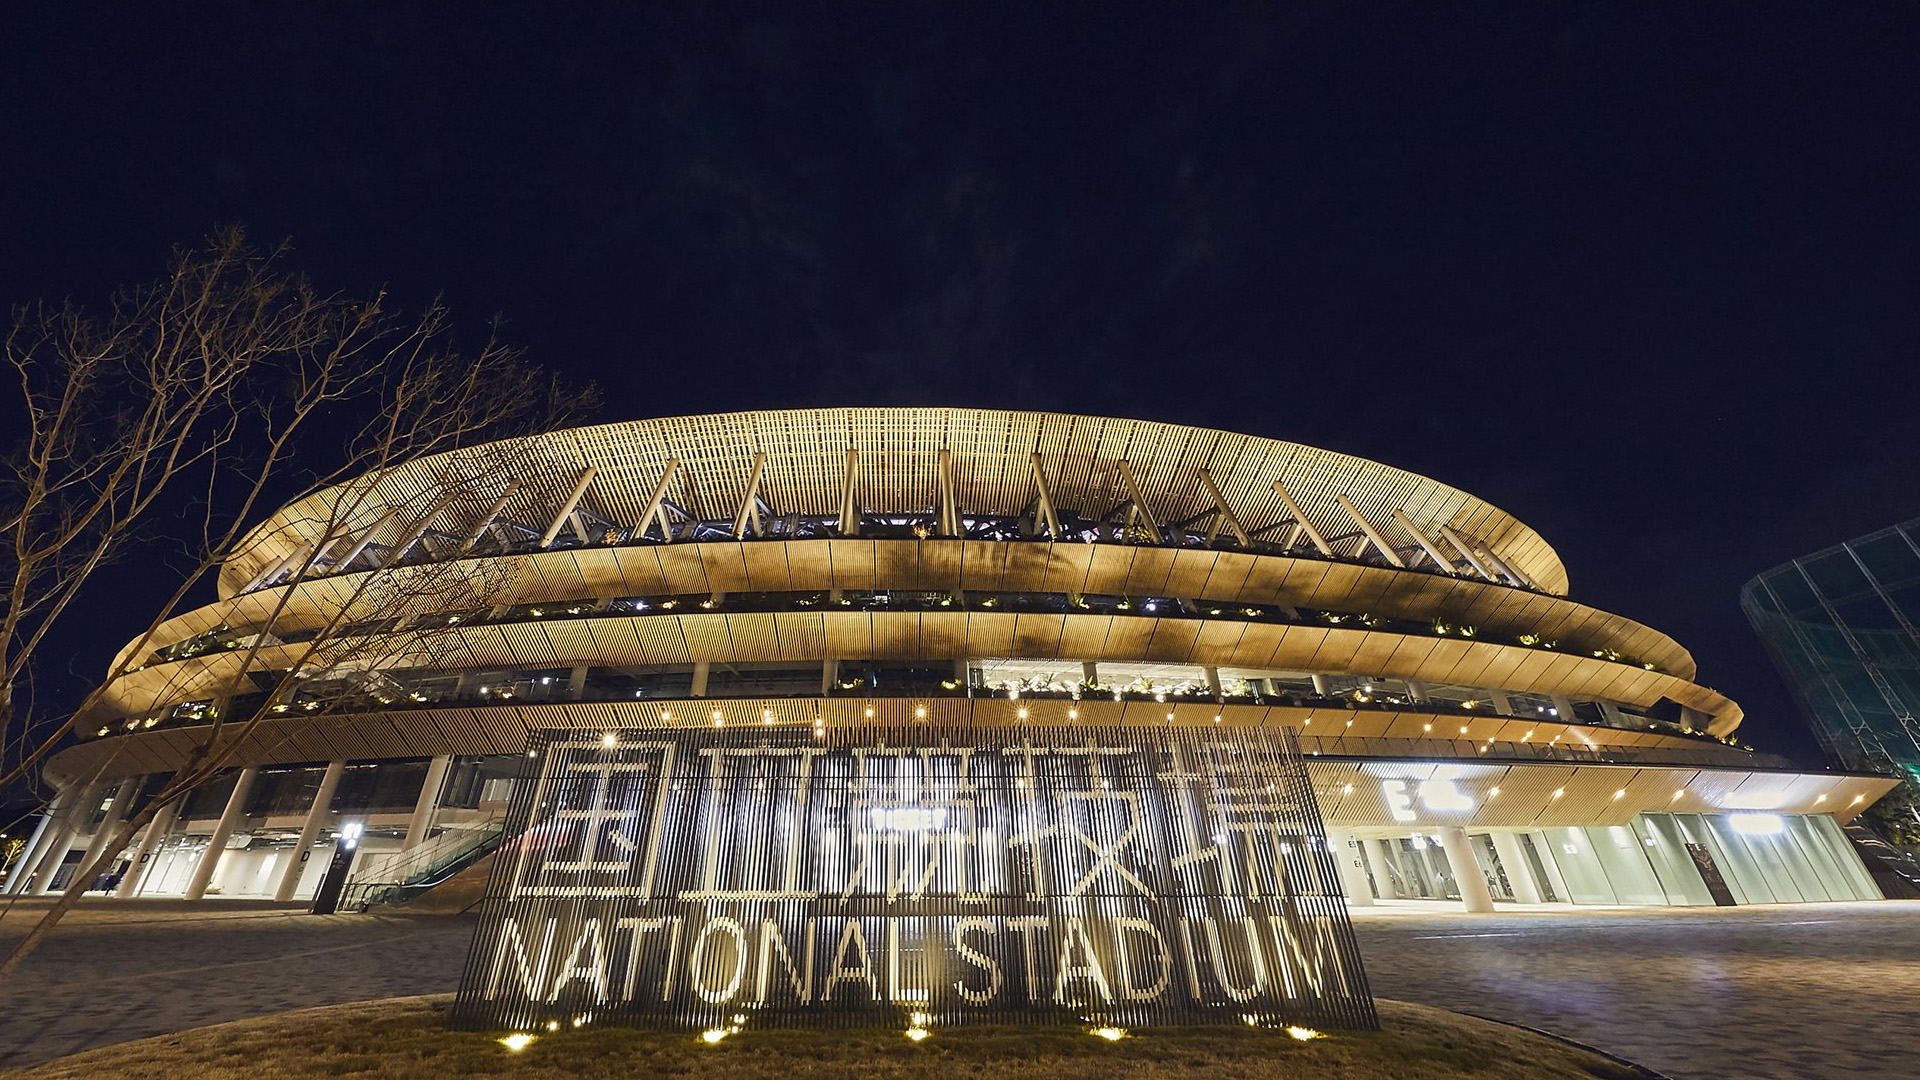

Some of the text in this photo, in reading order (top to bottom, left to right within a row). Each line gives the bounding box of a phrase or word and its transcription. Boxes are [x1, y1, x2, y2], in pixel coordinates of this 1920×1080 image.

[139, 852, 150, 864] D
[300, 850, 311, 862] D
[485, 914, 1351, 1005] NATIONAL STADIUM
